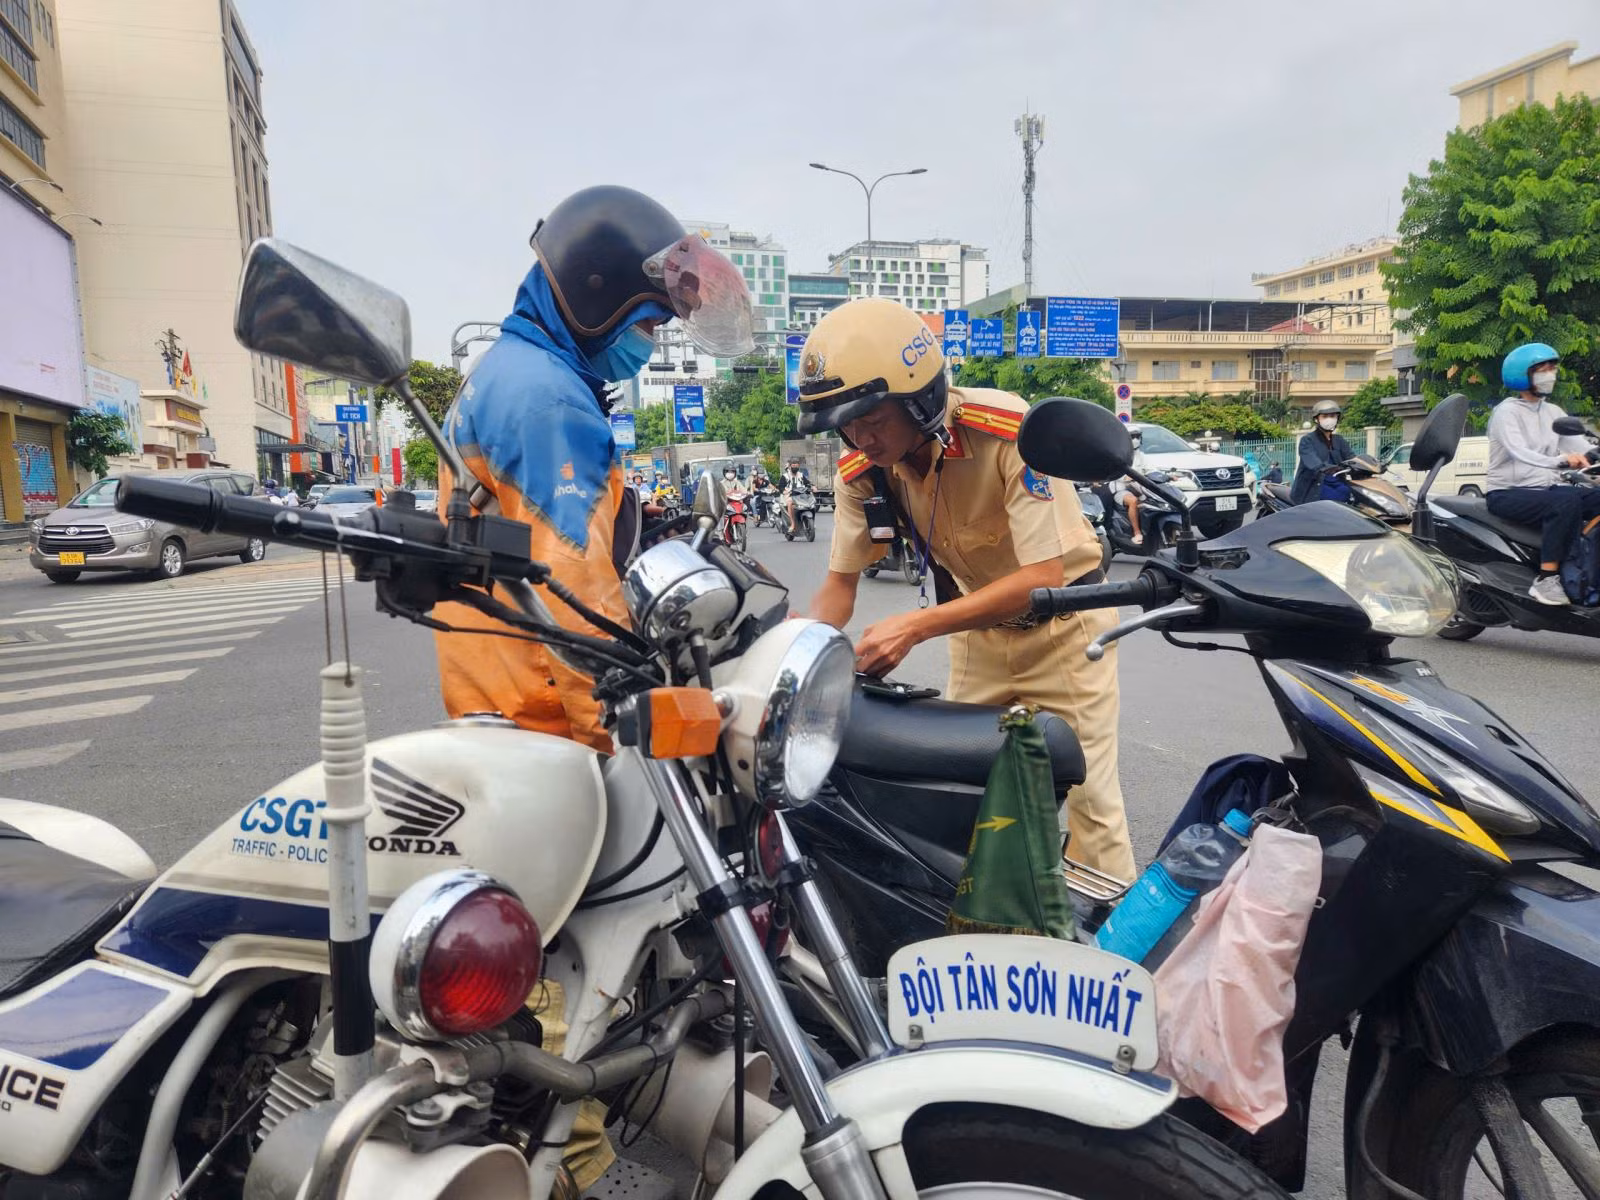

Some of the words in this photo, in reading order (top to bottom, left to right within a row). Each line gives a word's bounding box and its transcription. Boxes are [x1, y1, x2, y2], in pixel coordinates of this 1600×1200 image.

[232, 838, 277, 857] TRAFFIC
[287, 844, 328, 864] POLIC
[365, 836, 462, 856] ONDA
[898, 956, 945, 1024] ĐỘI
[947, 951, 999, 1011] TÂN
[1006, 960, 1057, 1018] SƠN
[1066, 968, 1143, 1038] NHẤT
[0, 1064, 66, 1111] ICE
